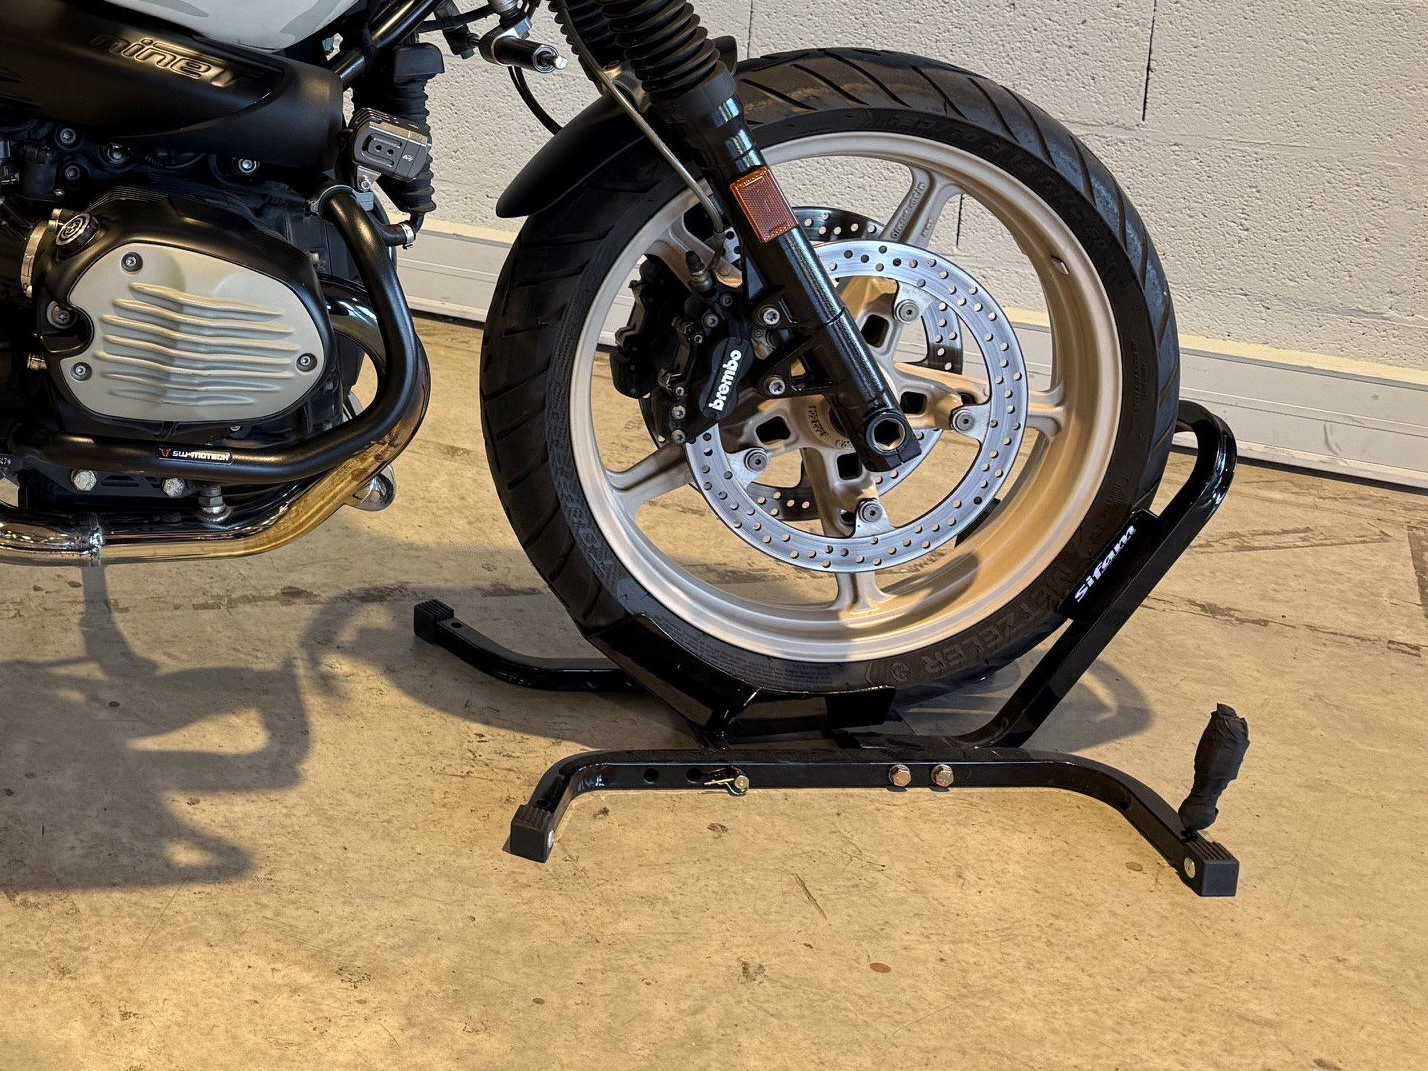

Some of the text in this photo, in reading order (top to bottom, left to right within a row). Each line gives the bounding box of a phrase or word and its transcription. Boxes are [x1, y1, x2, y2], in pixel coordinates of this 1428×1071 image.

[709, 349, 742, 411] brembo
[172, 450, 231, 461] SW-MOTECH
[1074, 525, 1136, 602] sifam
